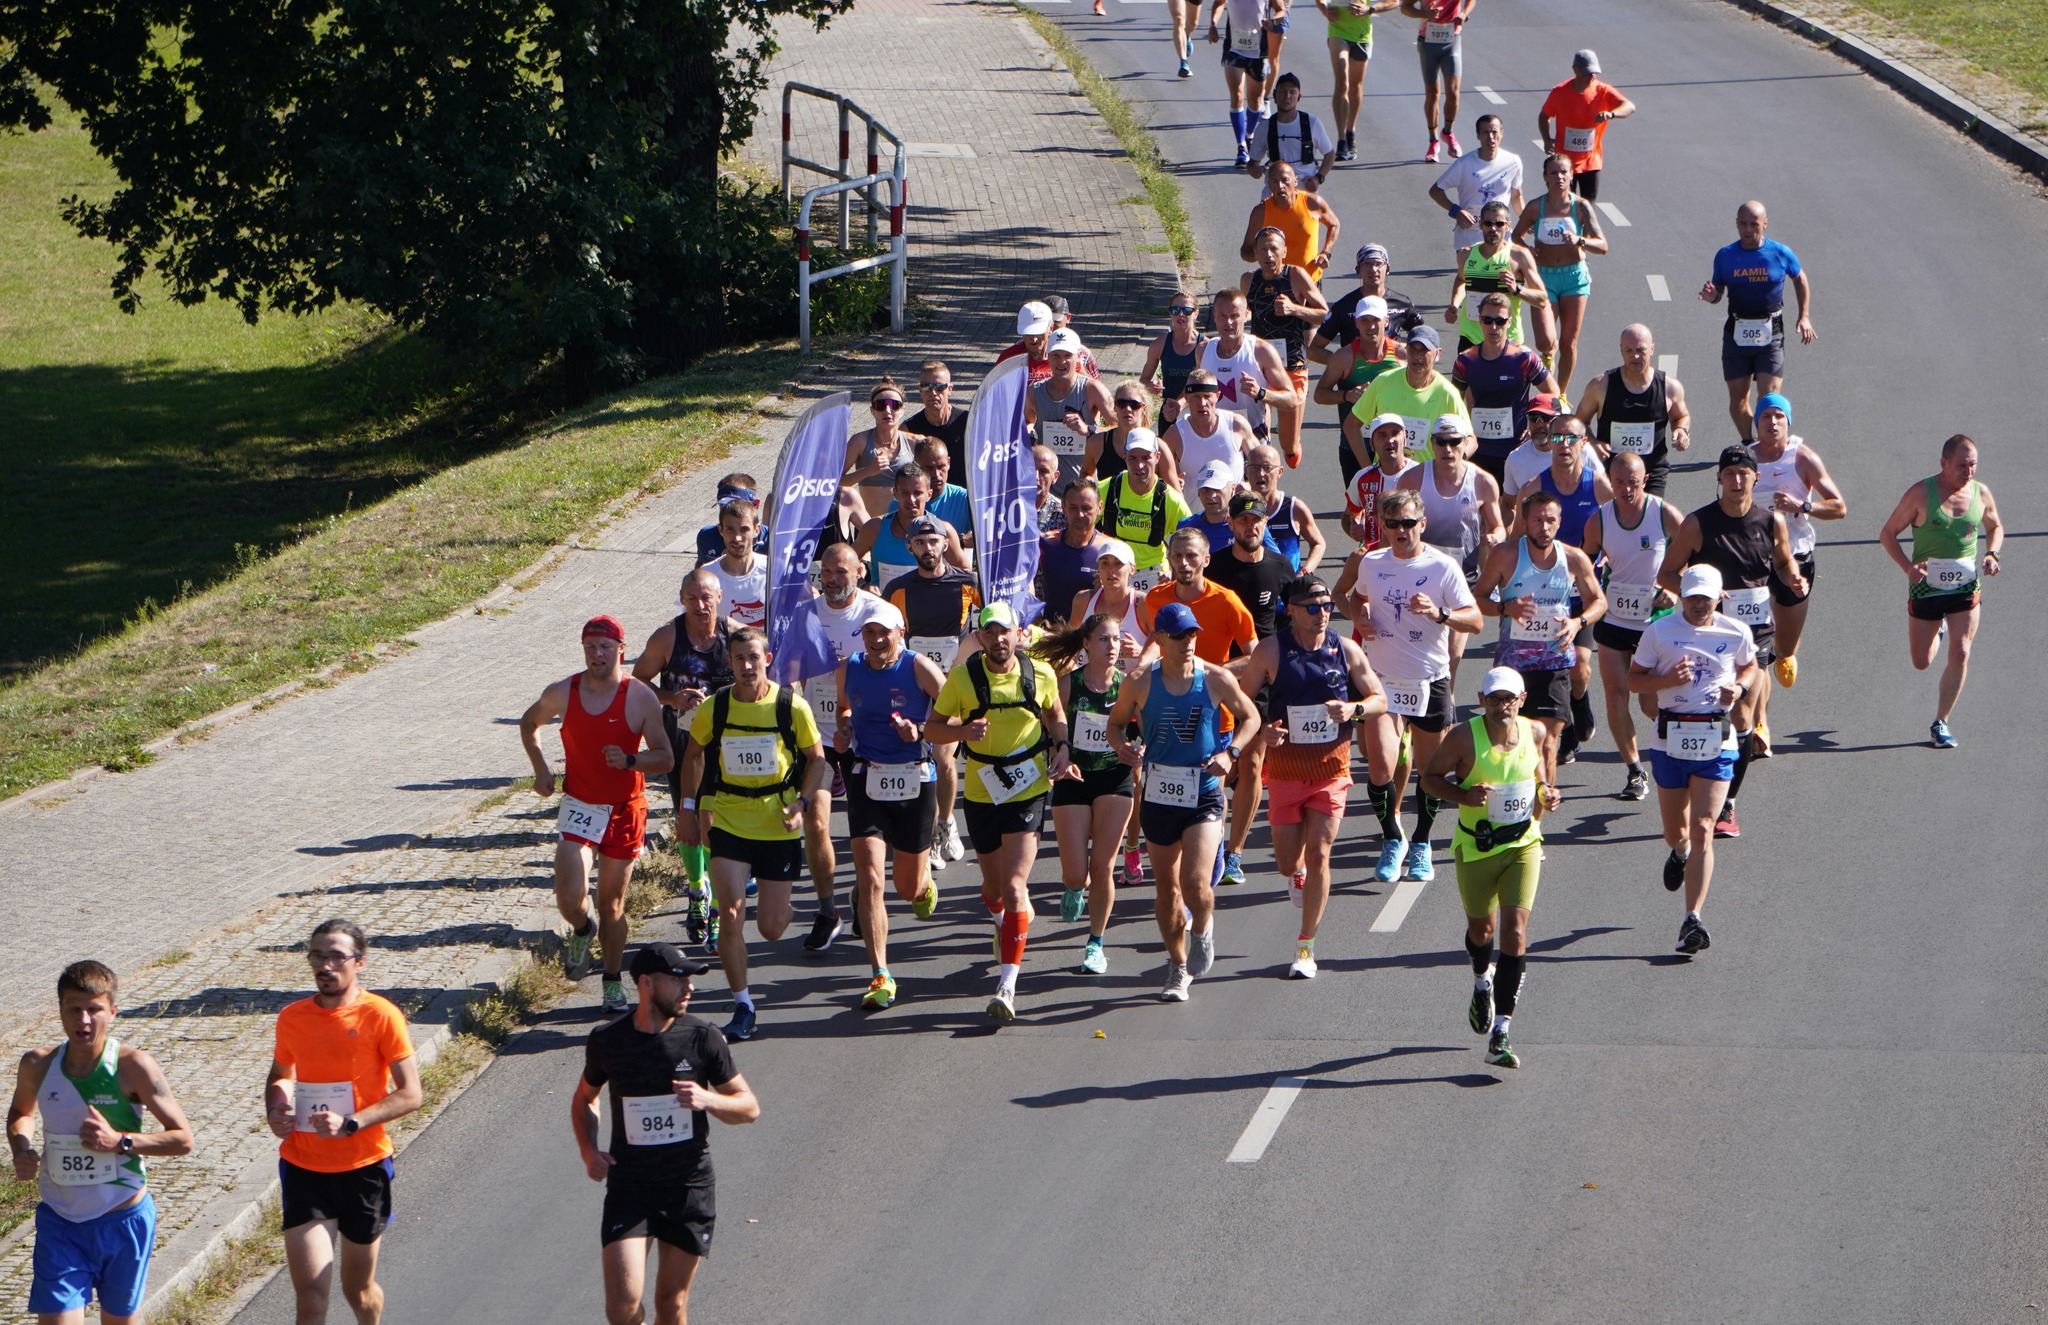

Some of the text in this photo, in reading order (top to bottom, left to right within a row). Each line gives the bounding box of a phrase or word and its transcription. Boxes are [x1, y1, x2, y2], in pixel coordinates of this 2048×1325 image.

[1430, 30, 1450, 39] 1075
[1238, 37, 1252, 46] 485
[1571, 137, 1588, 146] 486
[1547, 229, 1561, 238] 48
[1733, 267, 1769, 278] KAMIL
[1742, 329, 1761, 339] 505
[1481, 420, 1501, 431] 716
[1052, 435, 1074, 447] 382
[1621, 436, 1643, 447] 265
[1939, 571, 1963, 582] 692
[1617, 597, 1639, 610] 614
[1737, 603, 1760, 616] 526
[1524, 620, 1549, 632] 234
[1393, 693, 1418, 706] 330
[819, 700, 838, 713] 10
[1302, 720, 1327, 733] 492
[1681, 738, 1707, 750] 837
[737, 752, 762, 765] 180
[880, 777, 905, 790] 610
[1159, 781, 1184, 796] 398
[1504, 797, 1527, 812] 596
[567, 809, 593, 827] 724
[642, 1114, 675, 1132] 984
[62, 1155, 95, 1171] 582
